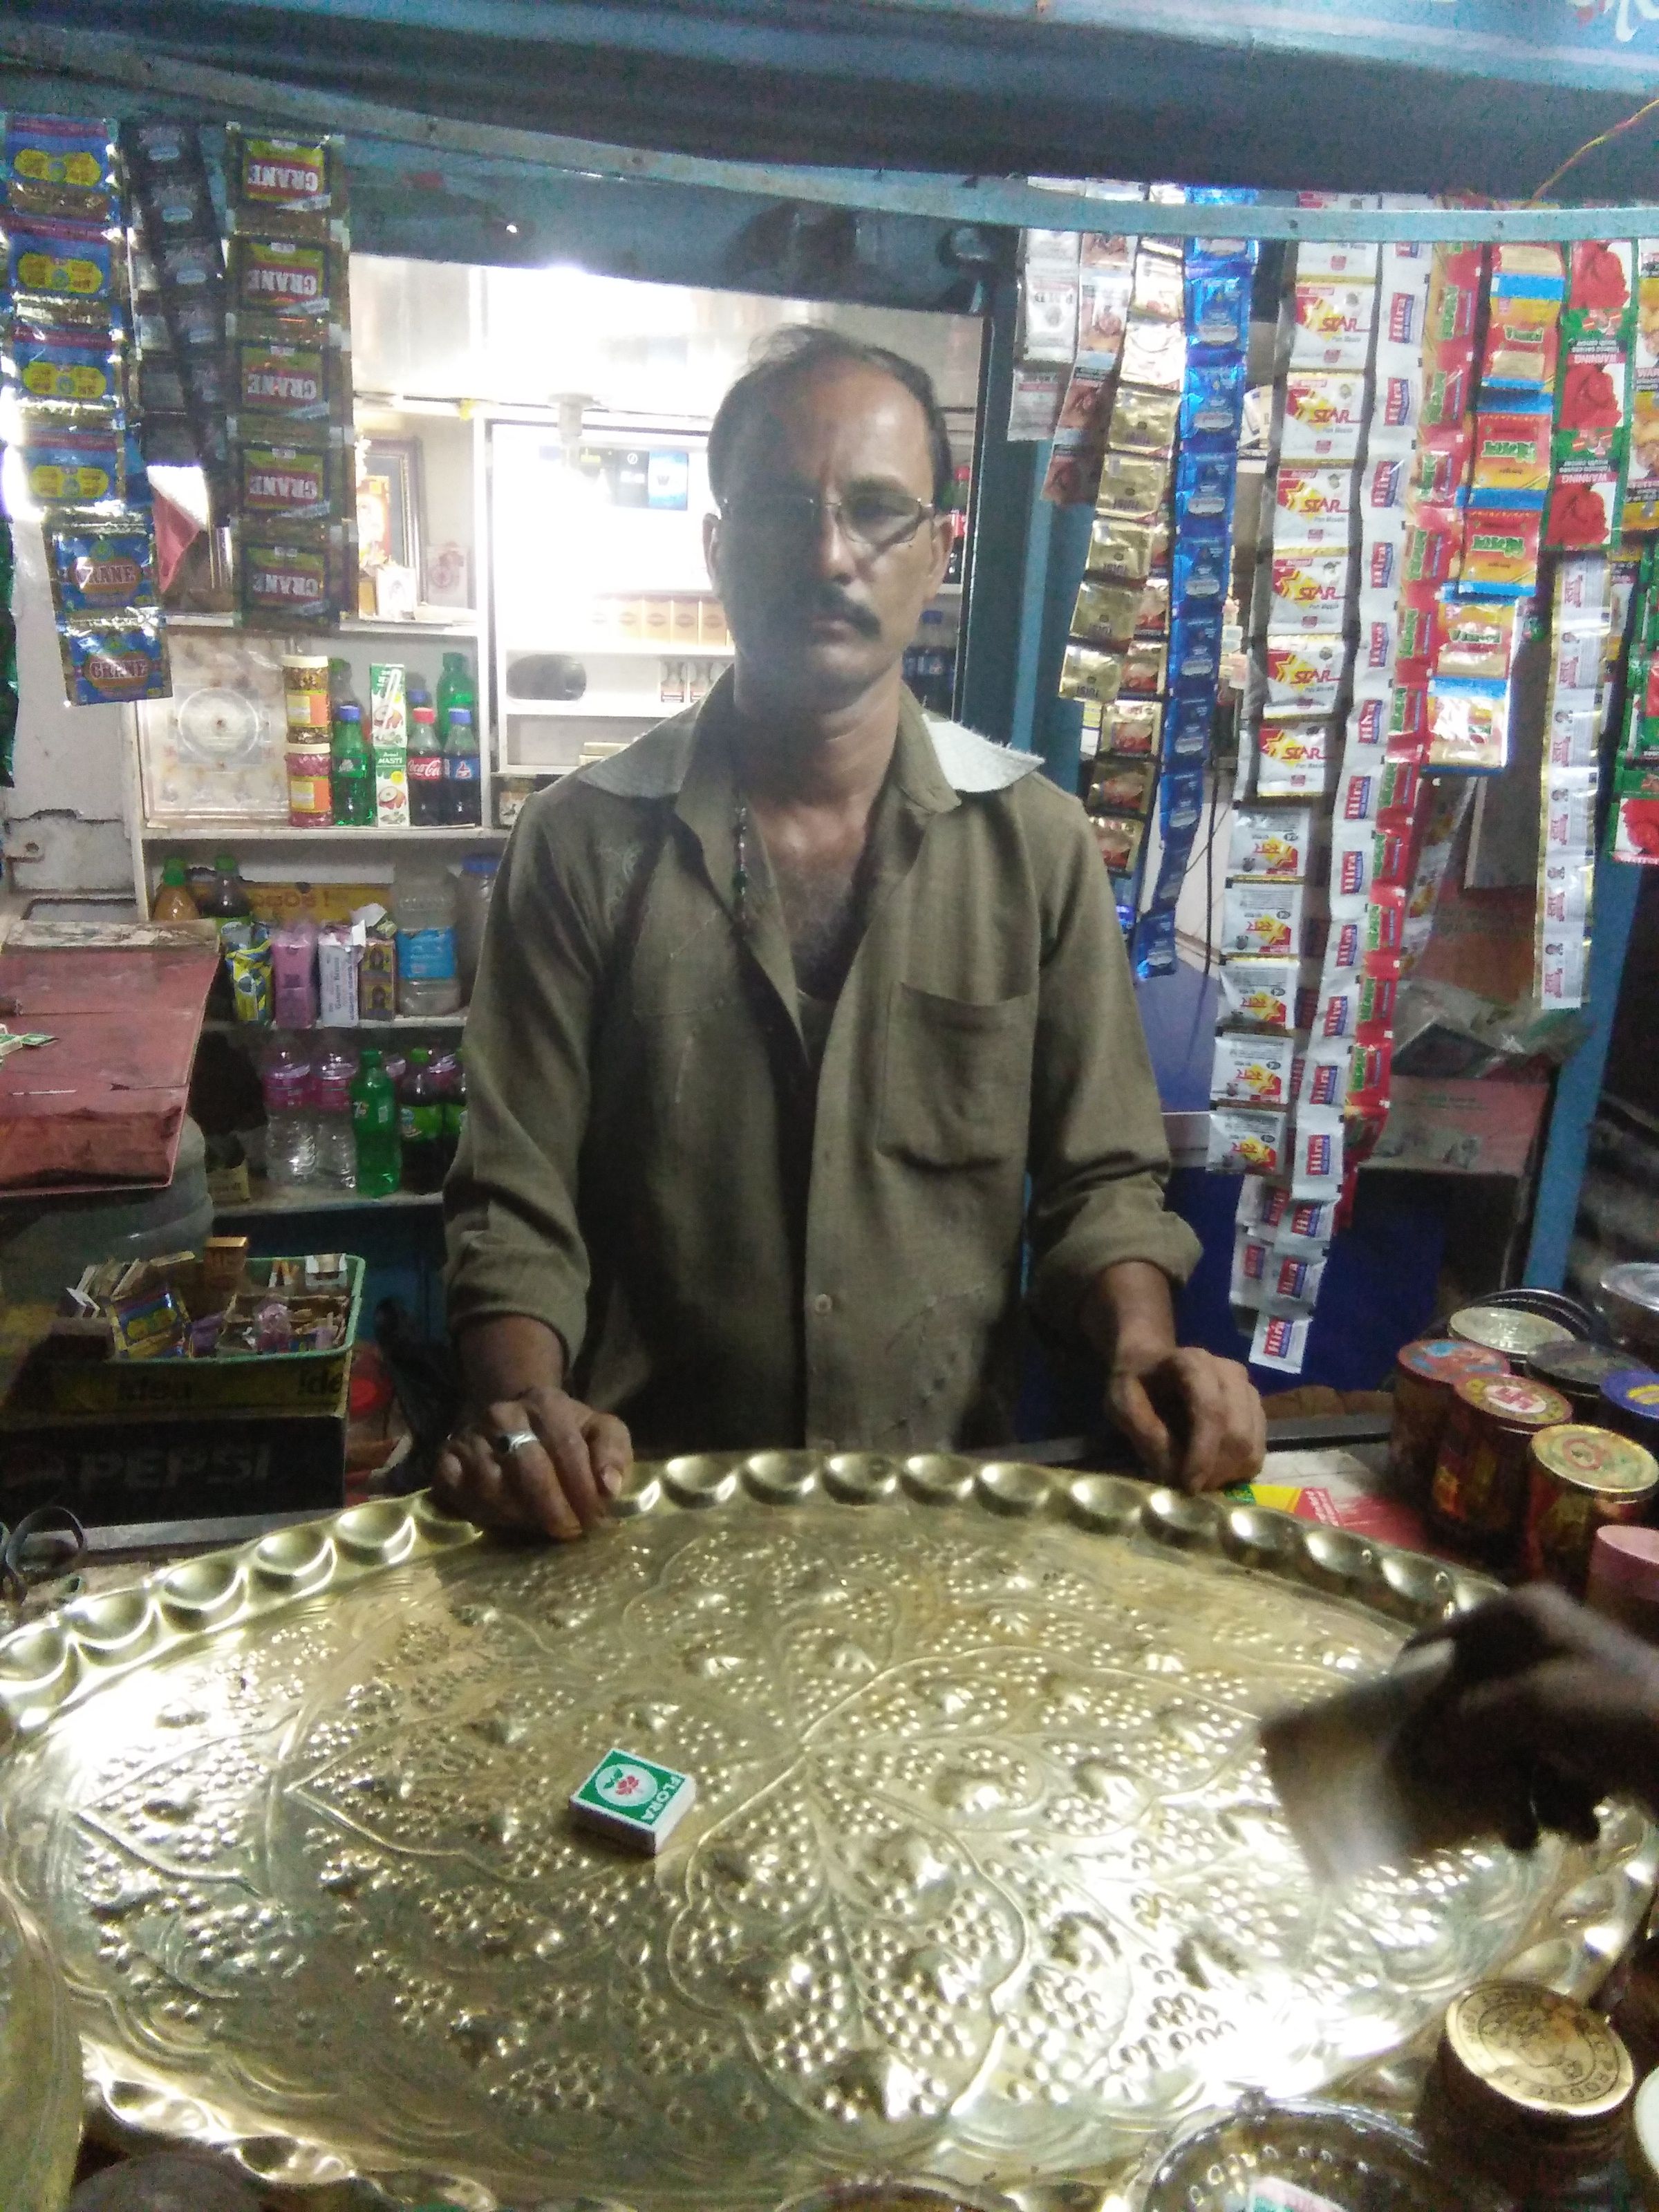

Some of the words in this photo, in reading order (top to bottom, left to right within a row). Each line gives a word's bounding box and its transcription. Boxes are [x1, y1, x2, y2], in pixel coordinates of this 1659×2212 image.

[1318, 316, 1369, 332] STAR
[1393, 297, 1405, 337] Hira
[1574, 354, 1617, 364] WARNING
[1308, 407, 1361, 423] STAR
[1562, 474, 1608, 484] WARNING
[1300, 498, 1350, 513] STAR
[1295, 586, 1345, 601] STAR
[1291, 670, 1342, 684] STAR
[1282, 747, 1330, 760] STAR
[1311, 1138, 1323, 1171] Hira
[78, 1443, 271, 1493] PEPSI
[641, 1776, 682, 1820] FLORA
